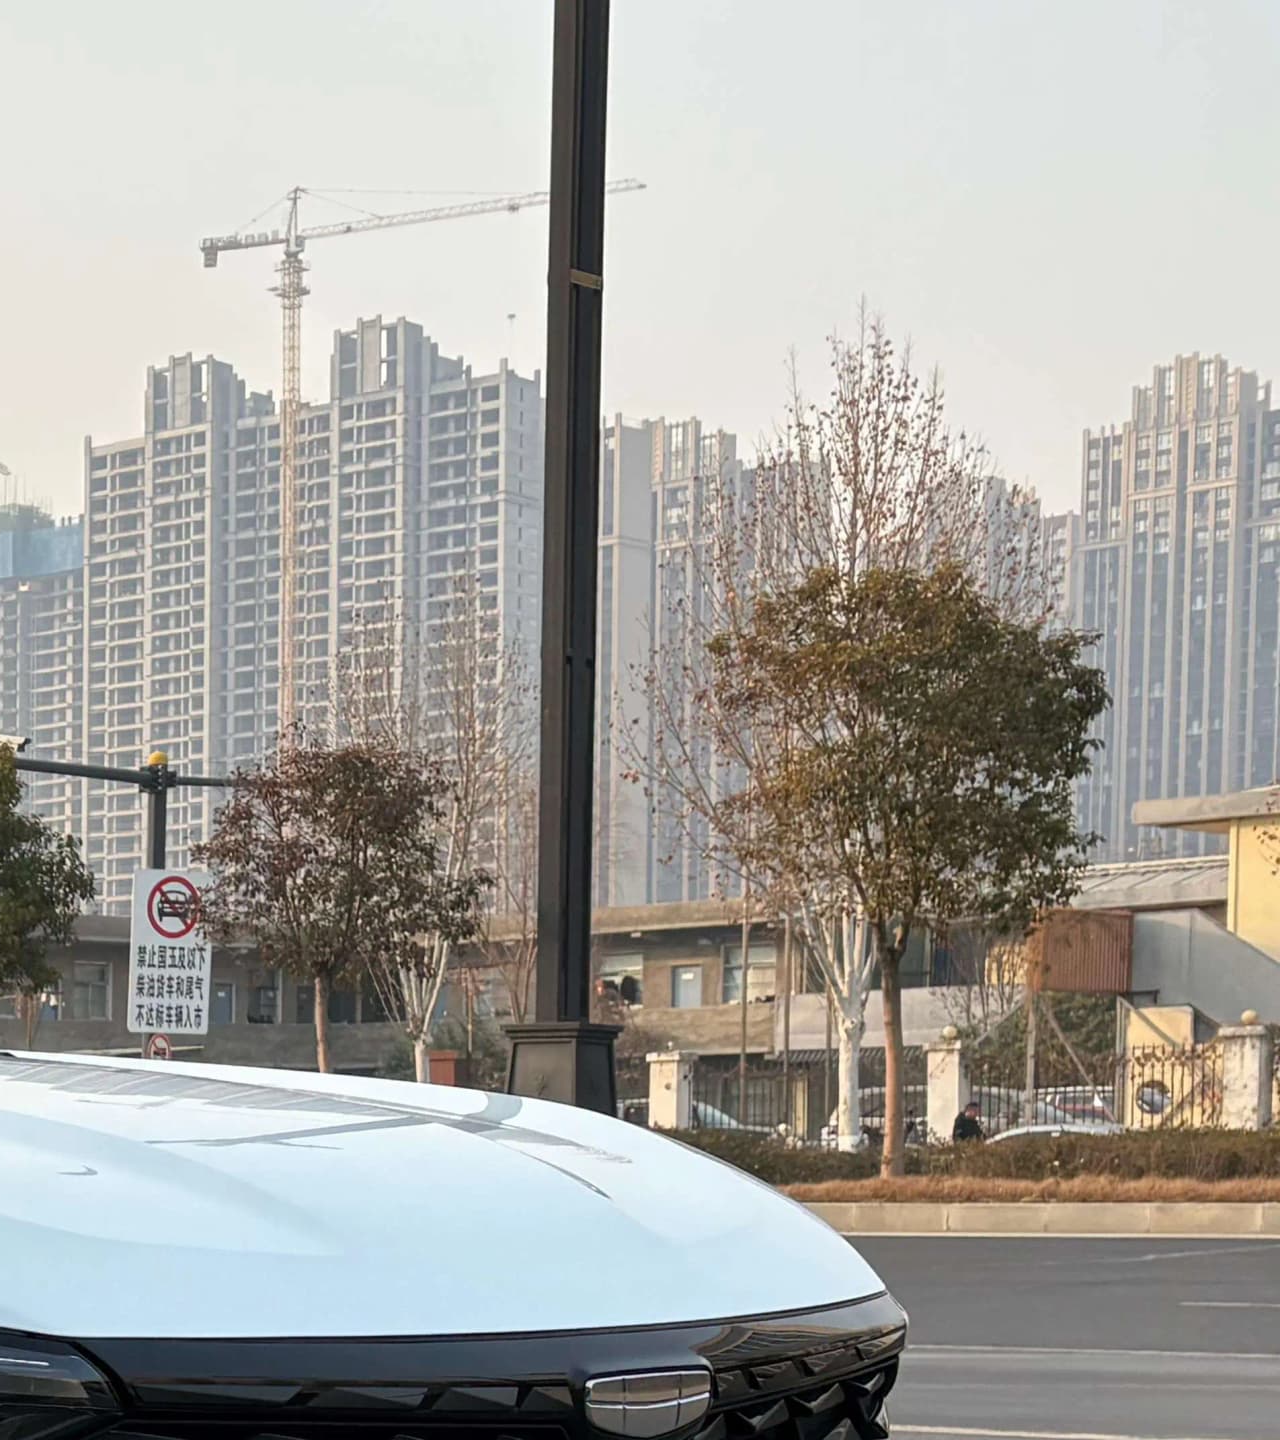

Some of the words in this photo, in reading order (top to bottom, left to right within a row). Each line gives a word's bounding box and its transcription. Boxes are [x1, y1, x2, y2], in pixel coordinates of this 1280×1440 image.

[135, 973, 204, 1000] 柴油货车和尾气
[135, 1002, 203, 1029] 不达标车辆入市
